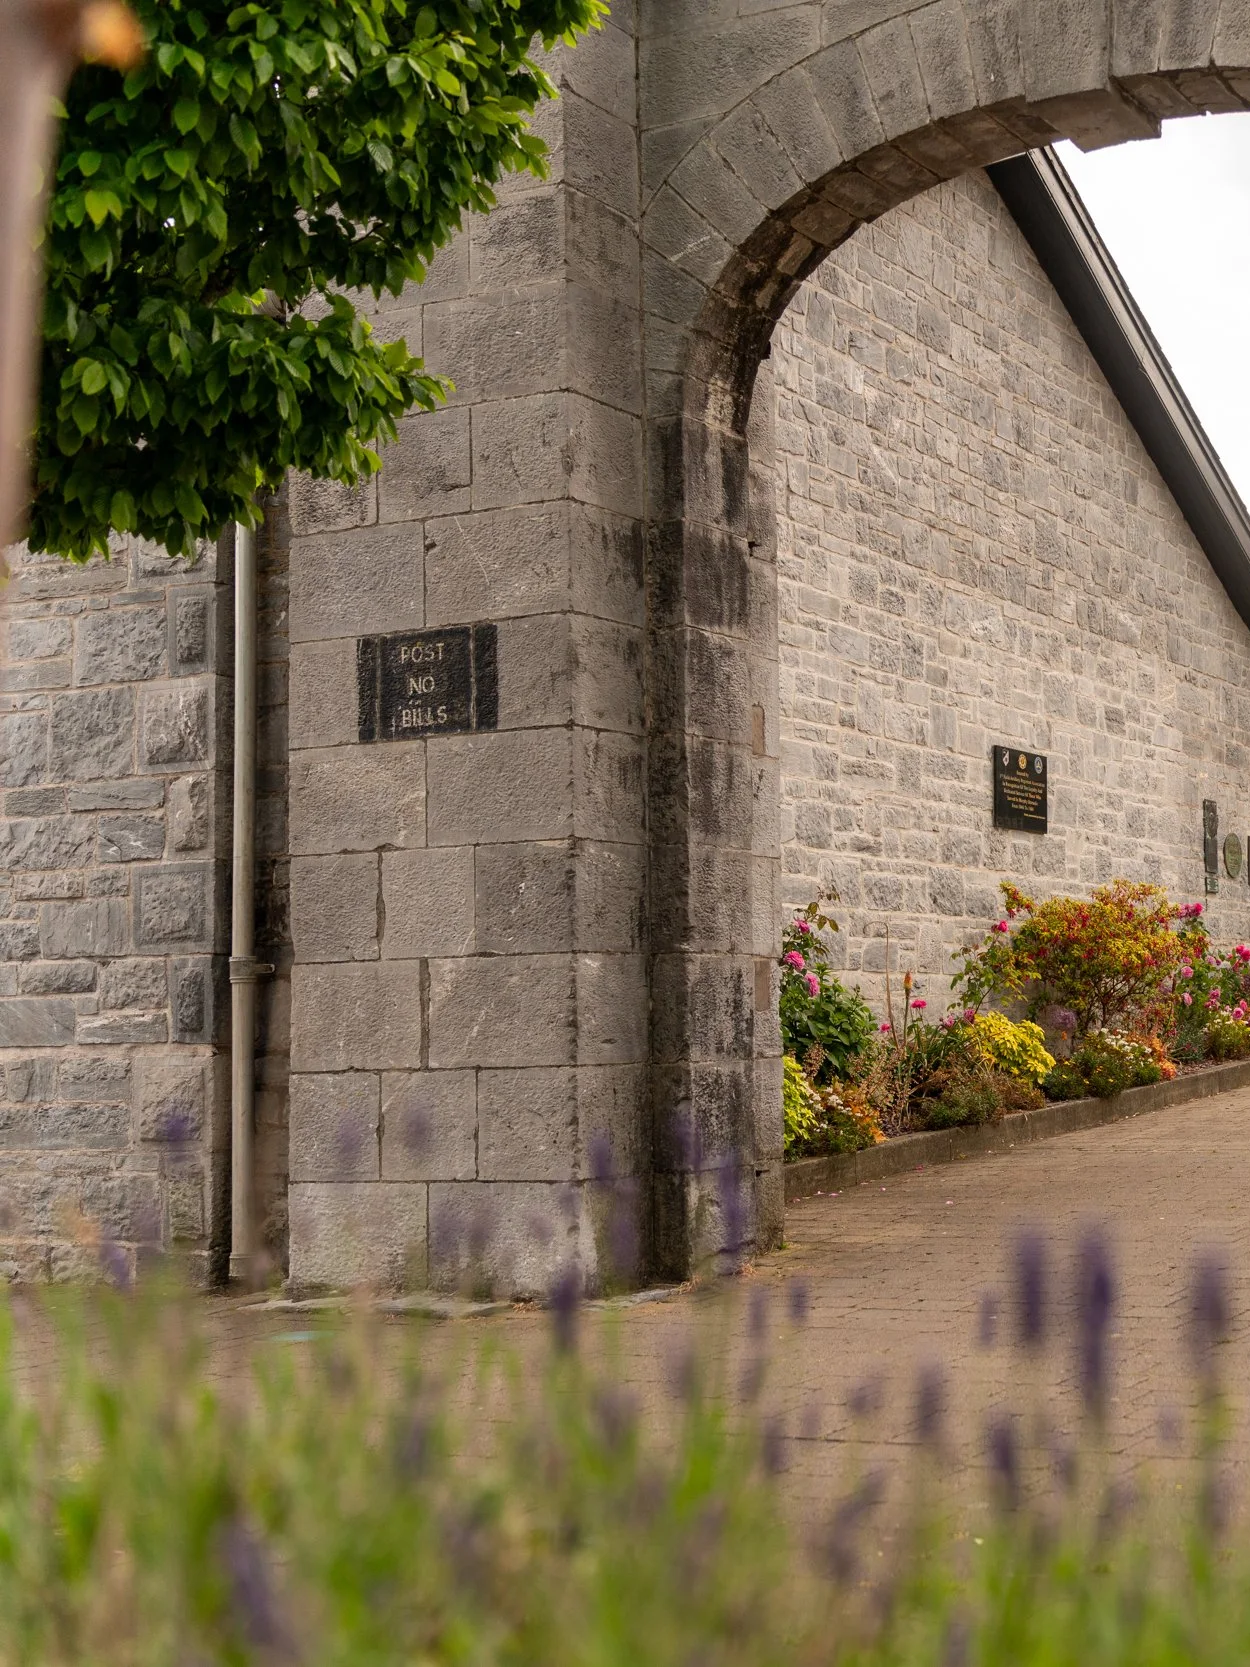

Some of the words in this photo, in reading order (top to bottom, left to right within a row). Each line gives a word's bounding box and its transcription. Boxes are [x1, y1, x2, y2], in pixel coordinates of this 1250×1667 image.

[400, 643, 445, 664] POST
[408, 676, 435, 695] NO
[402, 706, 448, 728] BILLS
